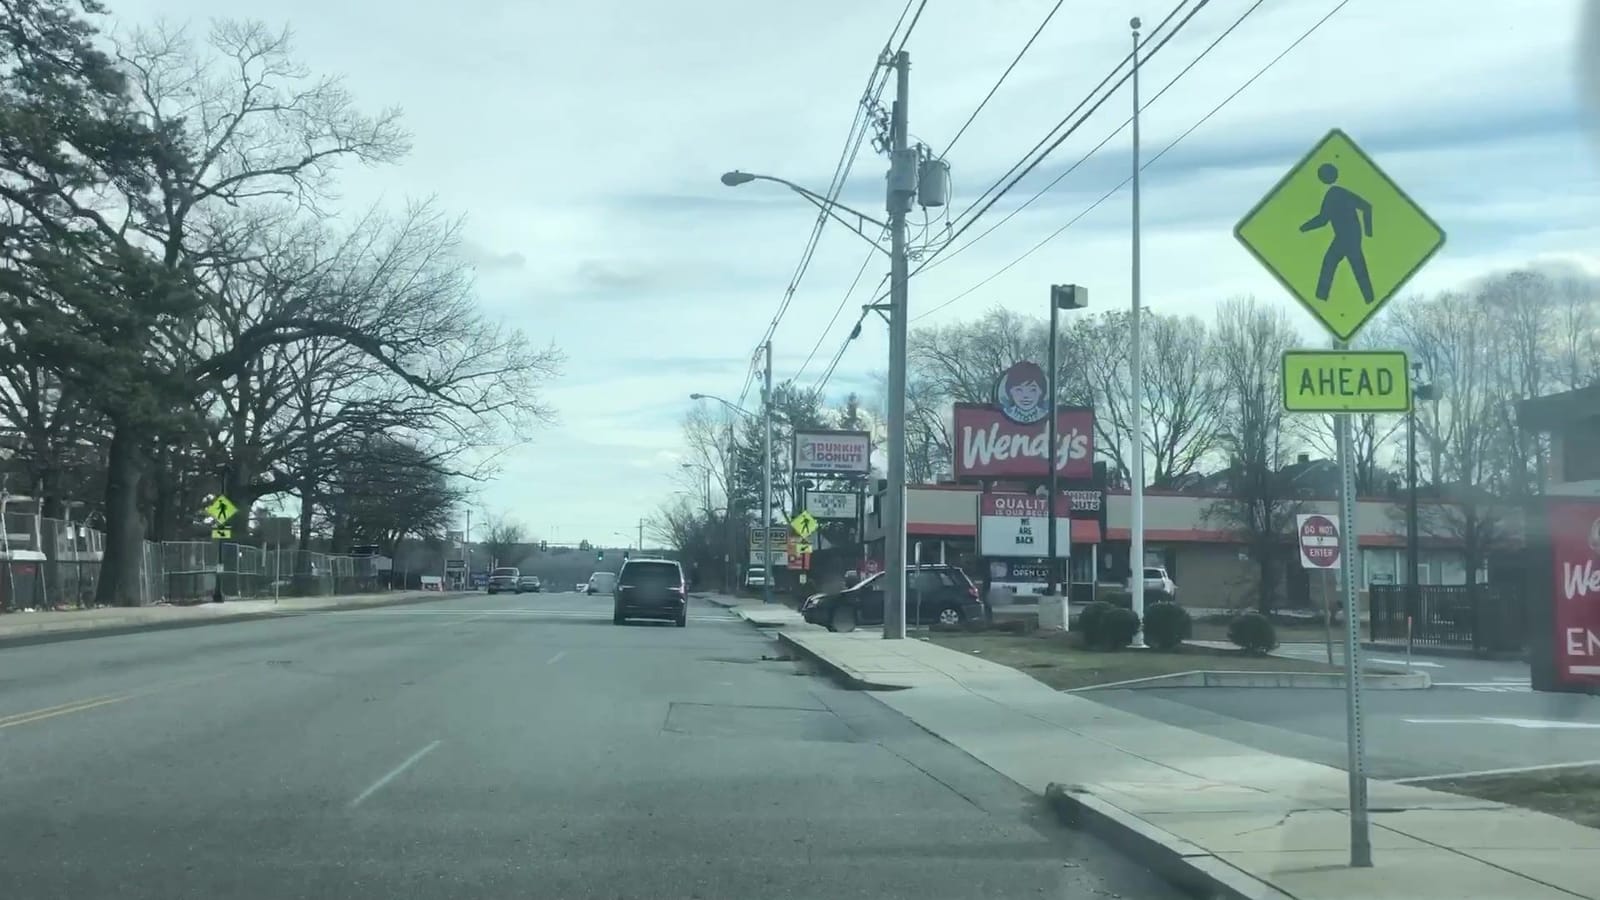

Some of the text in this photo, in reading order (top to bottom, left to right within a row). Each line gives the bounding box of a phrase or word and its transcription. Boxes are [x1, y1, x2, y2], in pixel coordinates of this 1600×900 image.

[1299, 368, 1394, 396] AHEAD
[816, 443, 865, 452] DUNKIN'
[963, 422, 1088, 470] Wendy's
[816, 453, 861, 462] DONUTS
[995, 498, 1048, 510] QUALIT
[1019, 527, 1032, 535] ARE
[1304, 525, 1333, 535] DO NOT
[1016, 536, 1034, 544] BACK
[1309, 548, 1333, 557] ENTER
[1013, 569, 1034, 577] OPEN
